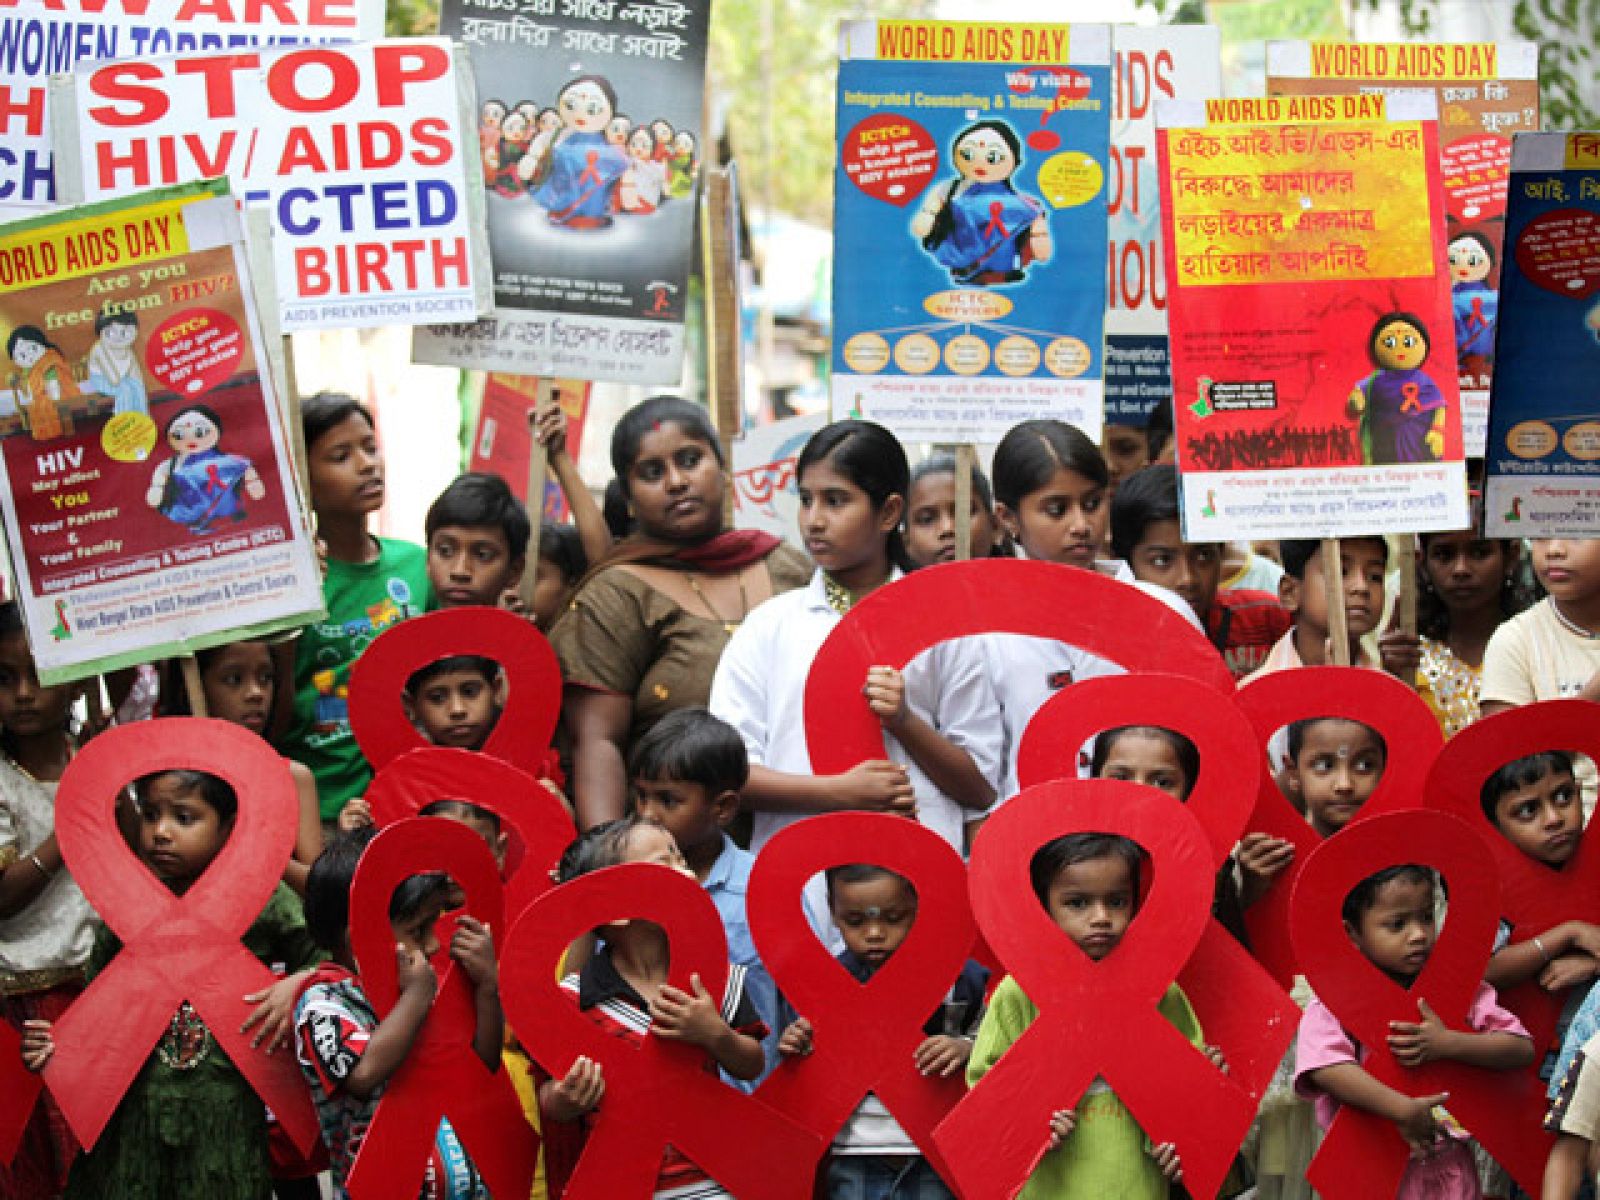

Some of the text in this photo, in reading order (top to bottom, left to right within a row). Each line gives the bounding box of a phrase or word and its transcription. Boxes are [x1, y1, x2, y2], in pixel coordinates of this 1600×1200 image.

[879, 25, 1066, 62] WORLD AIDS DAY
[1312, 45, 1496, 76] WORLD AIDS DAY
[88, 44, 450, 128] STOP
[1005, 72, 1036, 90] Why
[844, 91, 910, 108] Integrated
[994, 95, 1004, 110] &
[1009, 95, 1055, 113] Testing
[1206, 94, 1386, 123] WORLD AIDS DAY
[1174, 168, 1353, 196] বিরুদ্ধে আমাদের
[246, 180, 458, 235] CTED
[1177, 210, 1375, 240] লড়াইয়ের একমাত্র
[65, 227, 120, 271] AIDS
[125, 215, 171, 259] DAY
[294, 238, 470, 297] BIRTH
[1179, 246, 1271, 276] হাতিয়ার
[88, 262, 187, 295] Are you
[45, 274, 234, 330] free from HIV?
[285, 299, 474, 321] AIDS PREVENTION SOCIETY
[36, 446, 84, 475] HIV
[67, 507, 118, 526] Partner
[77, 539, 123, 558] Family
[43, 569, 95, 592] Integrated
